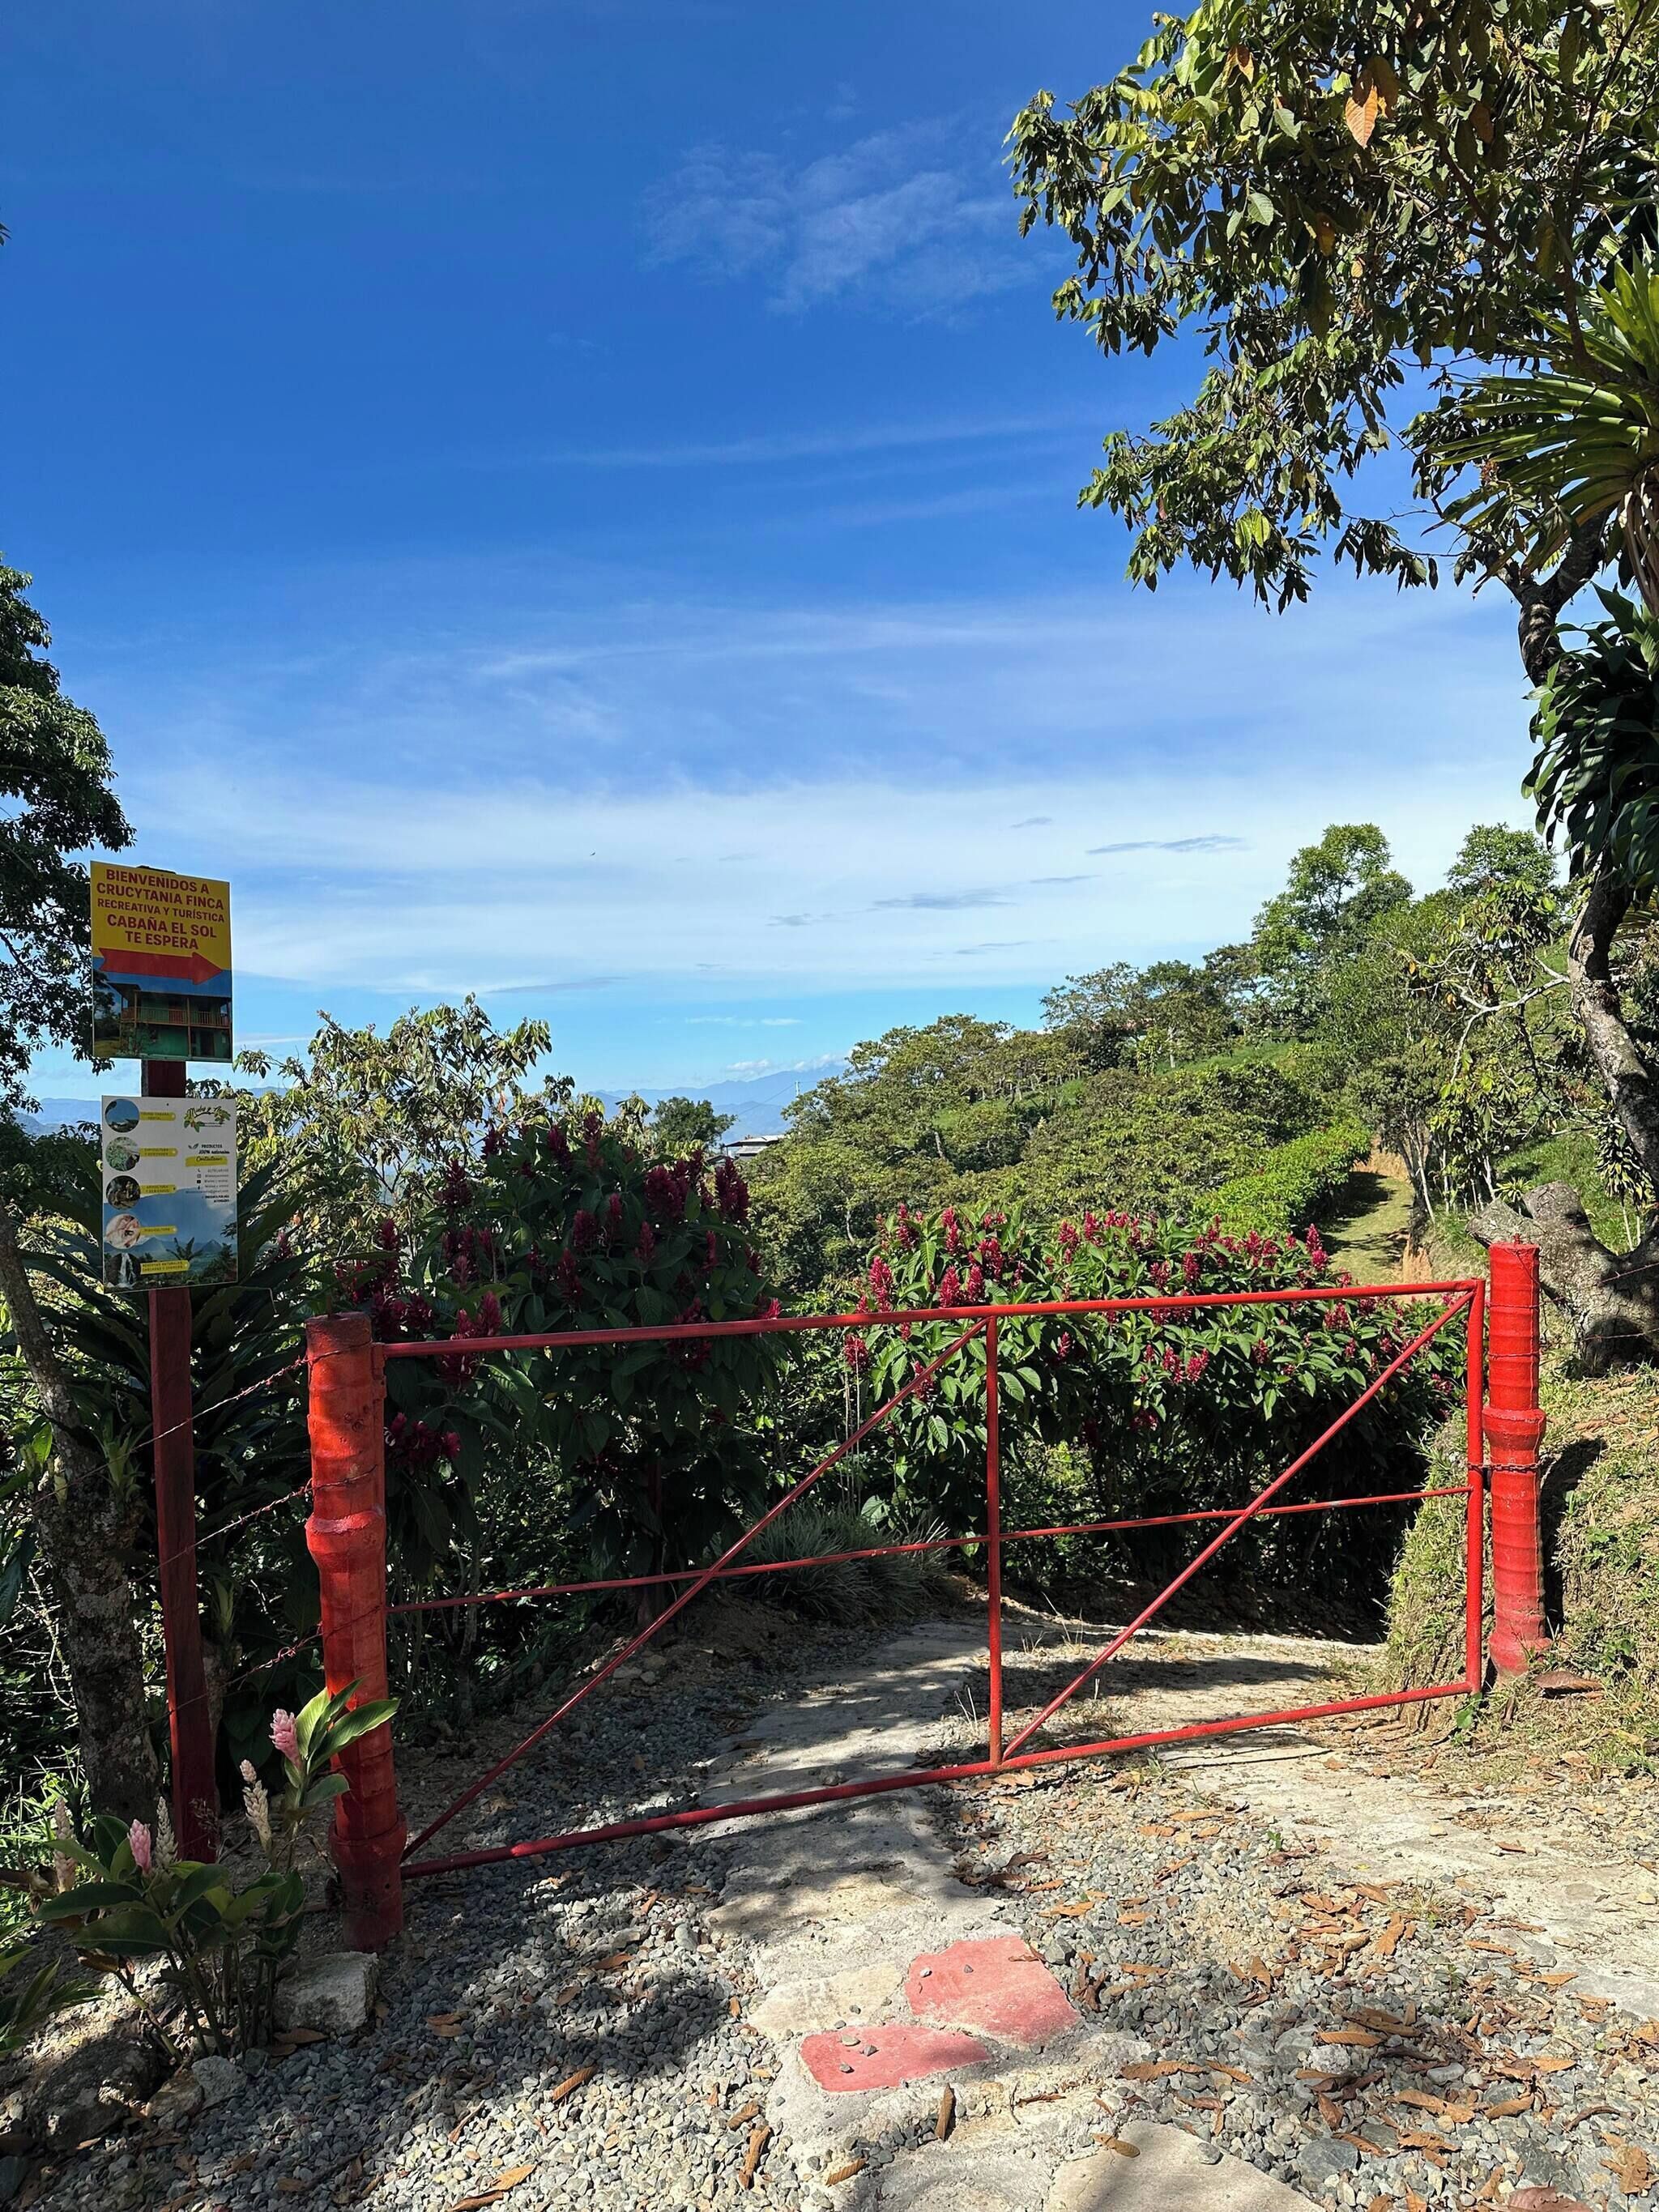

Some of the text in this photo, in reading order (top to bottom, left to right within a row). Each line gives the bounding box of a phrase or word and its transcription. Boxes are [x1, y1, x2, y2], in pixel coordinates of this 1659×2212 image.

[106, 869, 209, 894] BIENVENIDOS A
[96, 883, 224, 910] CRUCYTANIA FINCA
[97, 898, 224, 923] RECREATIVA Y TURÍSTICA
[107, 914, 217, 938] CABAÑA EL SOL
[125, 931, 198, 949] TE ESPERA
